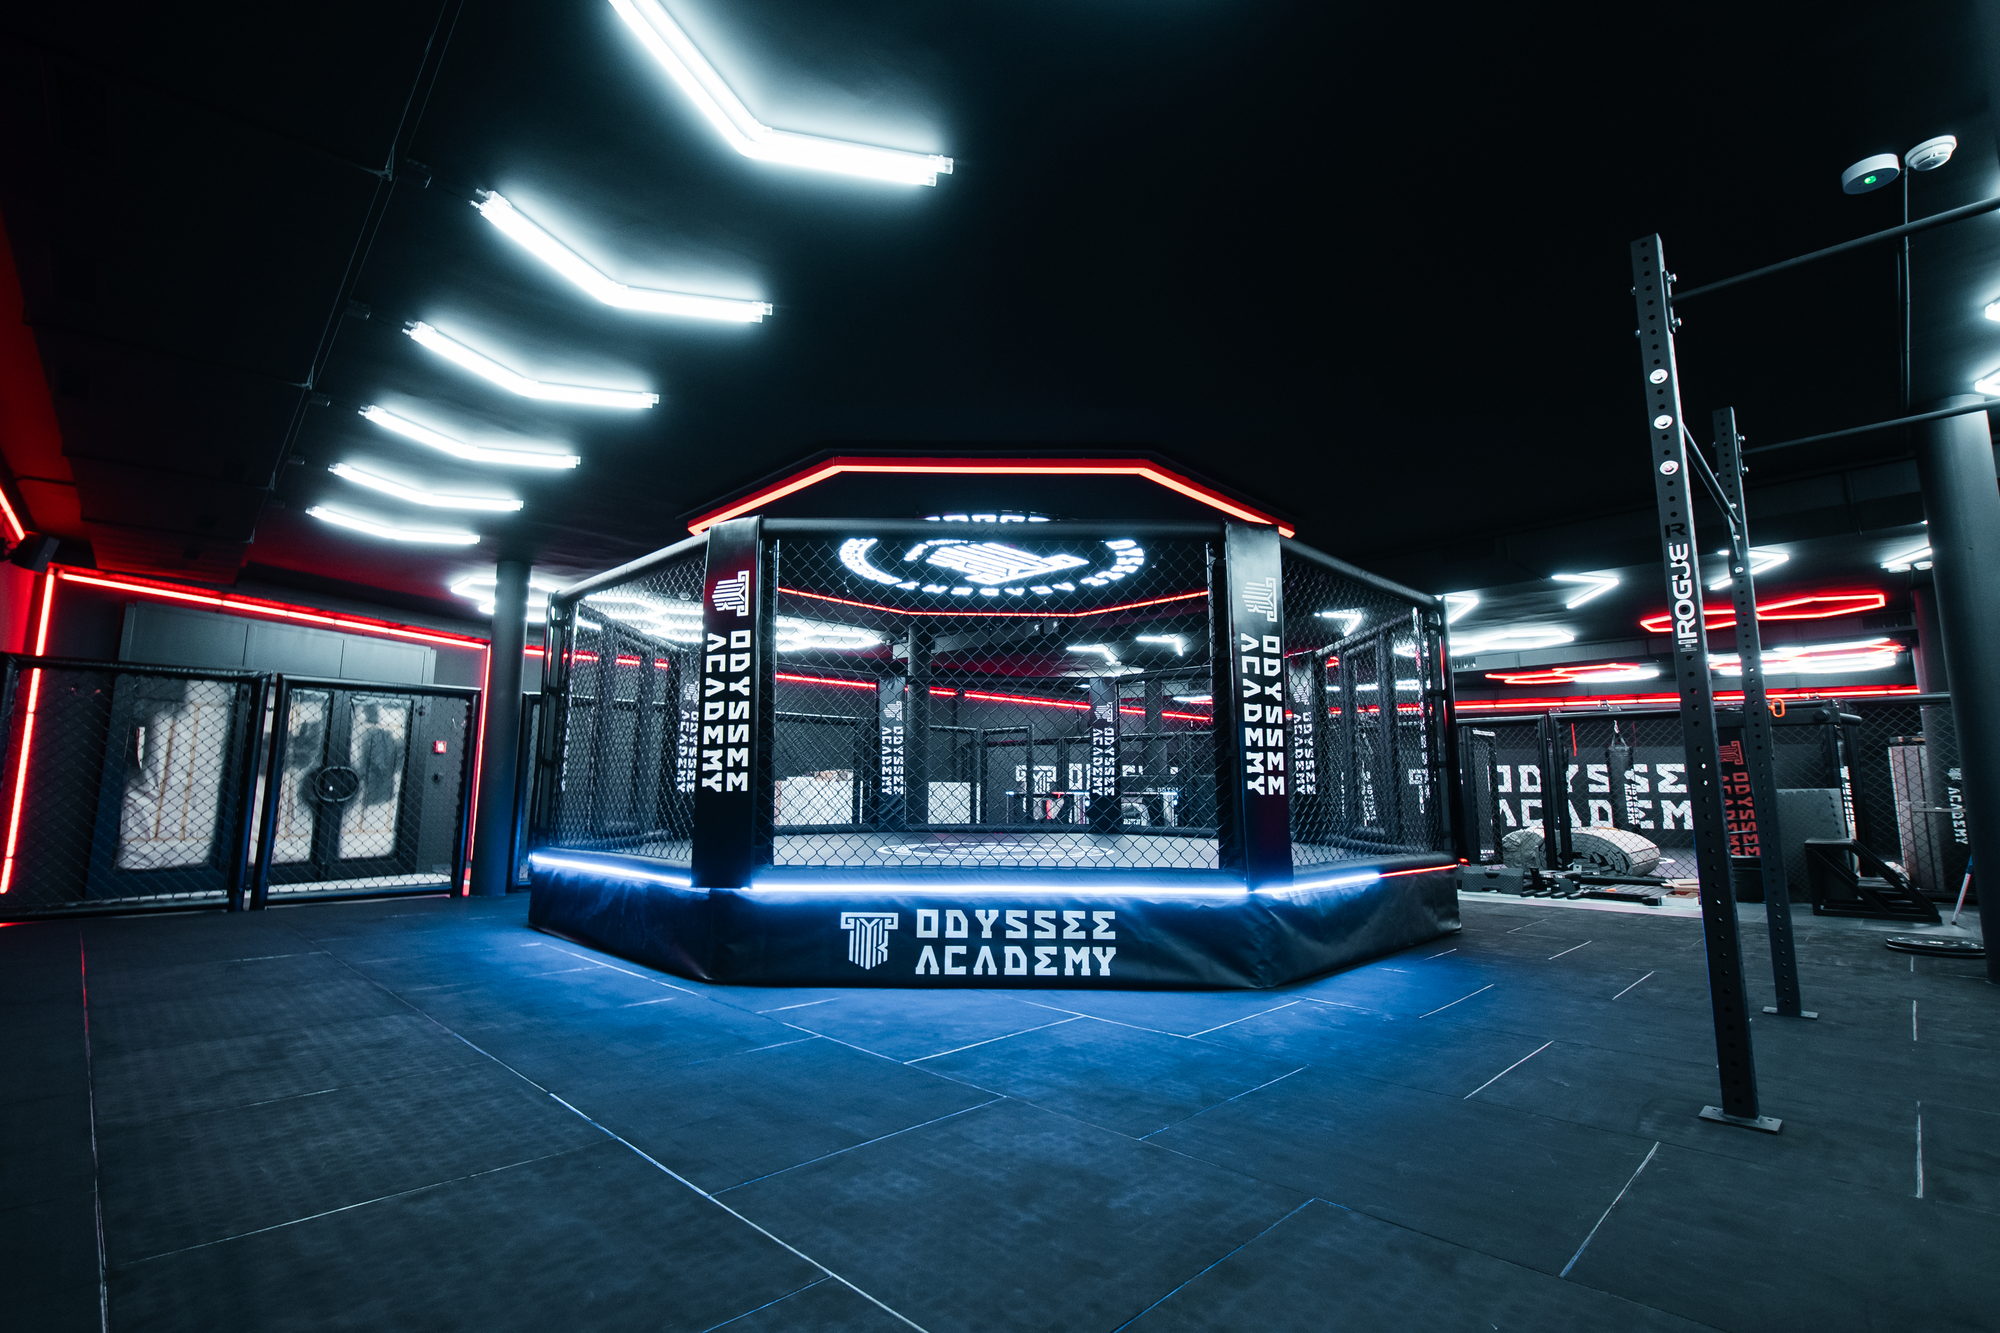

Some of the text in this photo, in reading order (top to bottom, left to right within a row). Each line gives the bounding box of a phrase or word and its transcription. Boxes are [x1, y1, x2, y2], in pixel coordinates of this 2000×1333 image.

[1668, 542, 1698, 640] ROGUE
[676, 710, 690, 793] ACADEMY
[701, 633, 727, 793] ACADEMY
[727, 629, 750, 792] ODYSSEE
[1240, 633, 1266, 797] ACADEMY
[1262, 636, 1286, 796] ODYSSEE
[881, 727, 893, 796] ACADEMY
[892, 726, 904, 795] ODYSSEE
[1090, 728, 1104, 797] ACADEMY
[1103, 728, 1115, 797] ODYSSEE
[1732, 771, 1761, 856] ODYSSEE
[915, 945, 1117, 976] ACADEMY
[916, 908, 1117, 940] ODYSSEE
